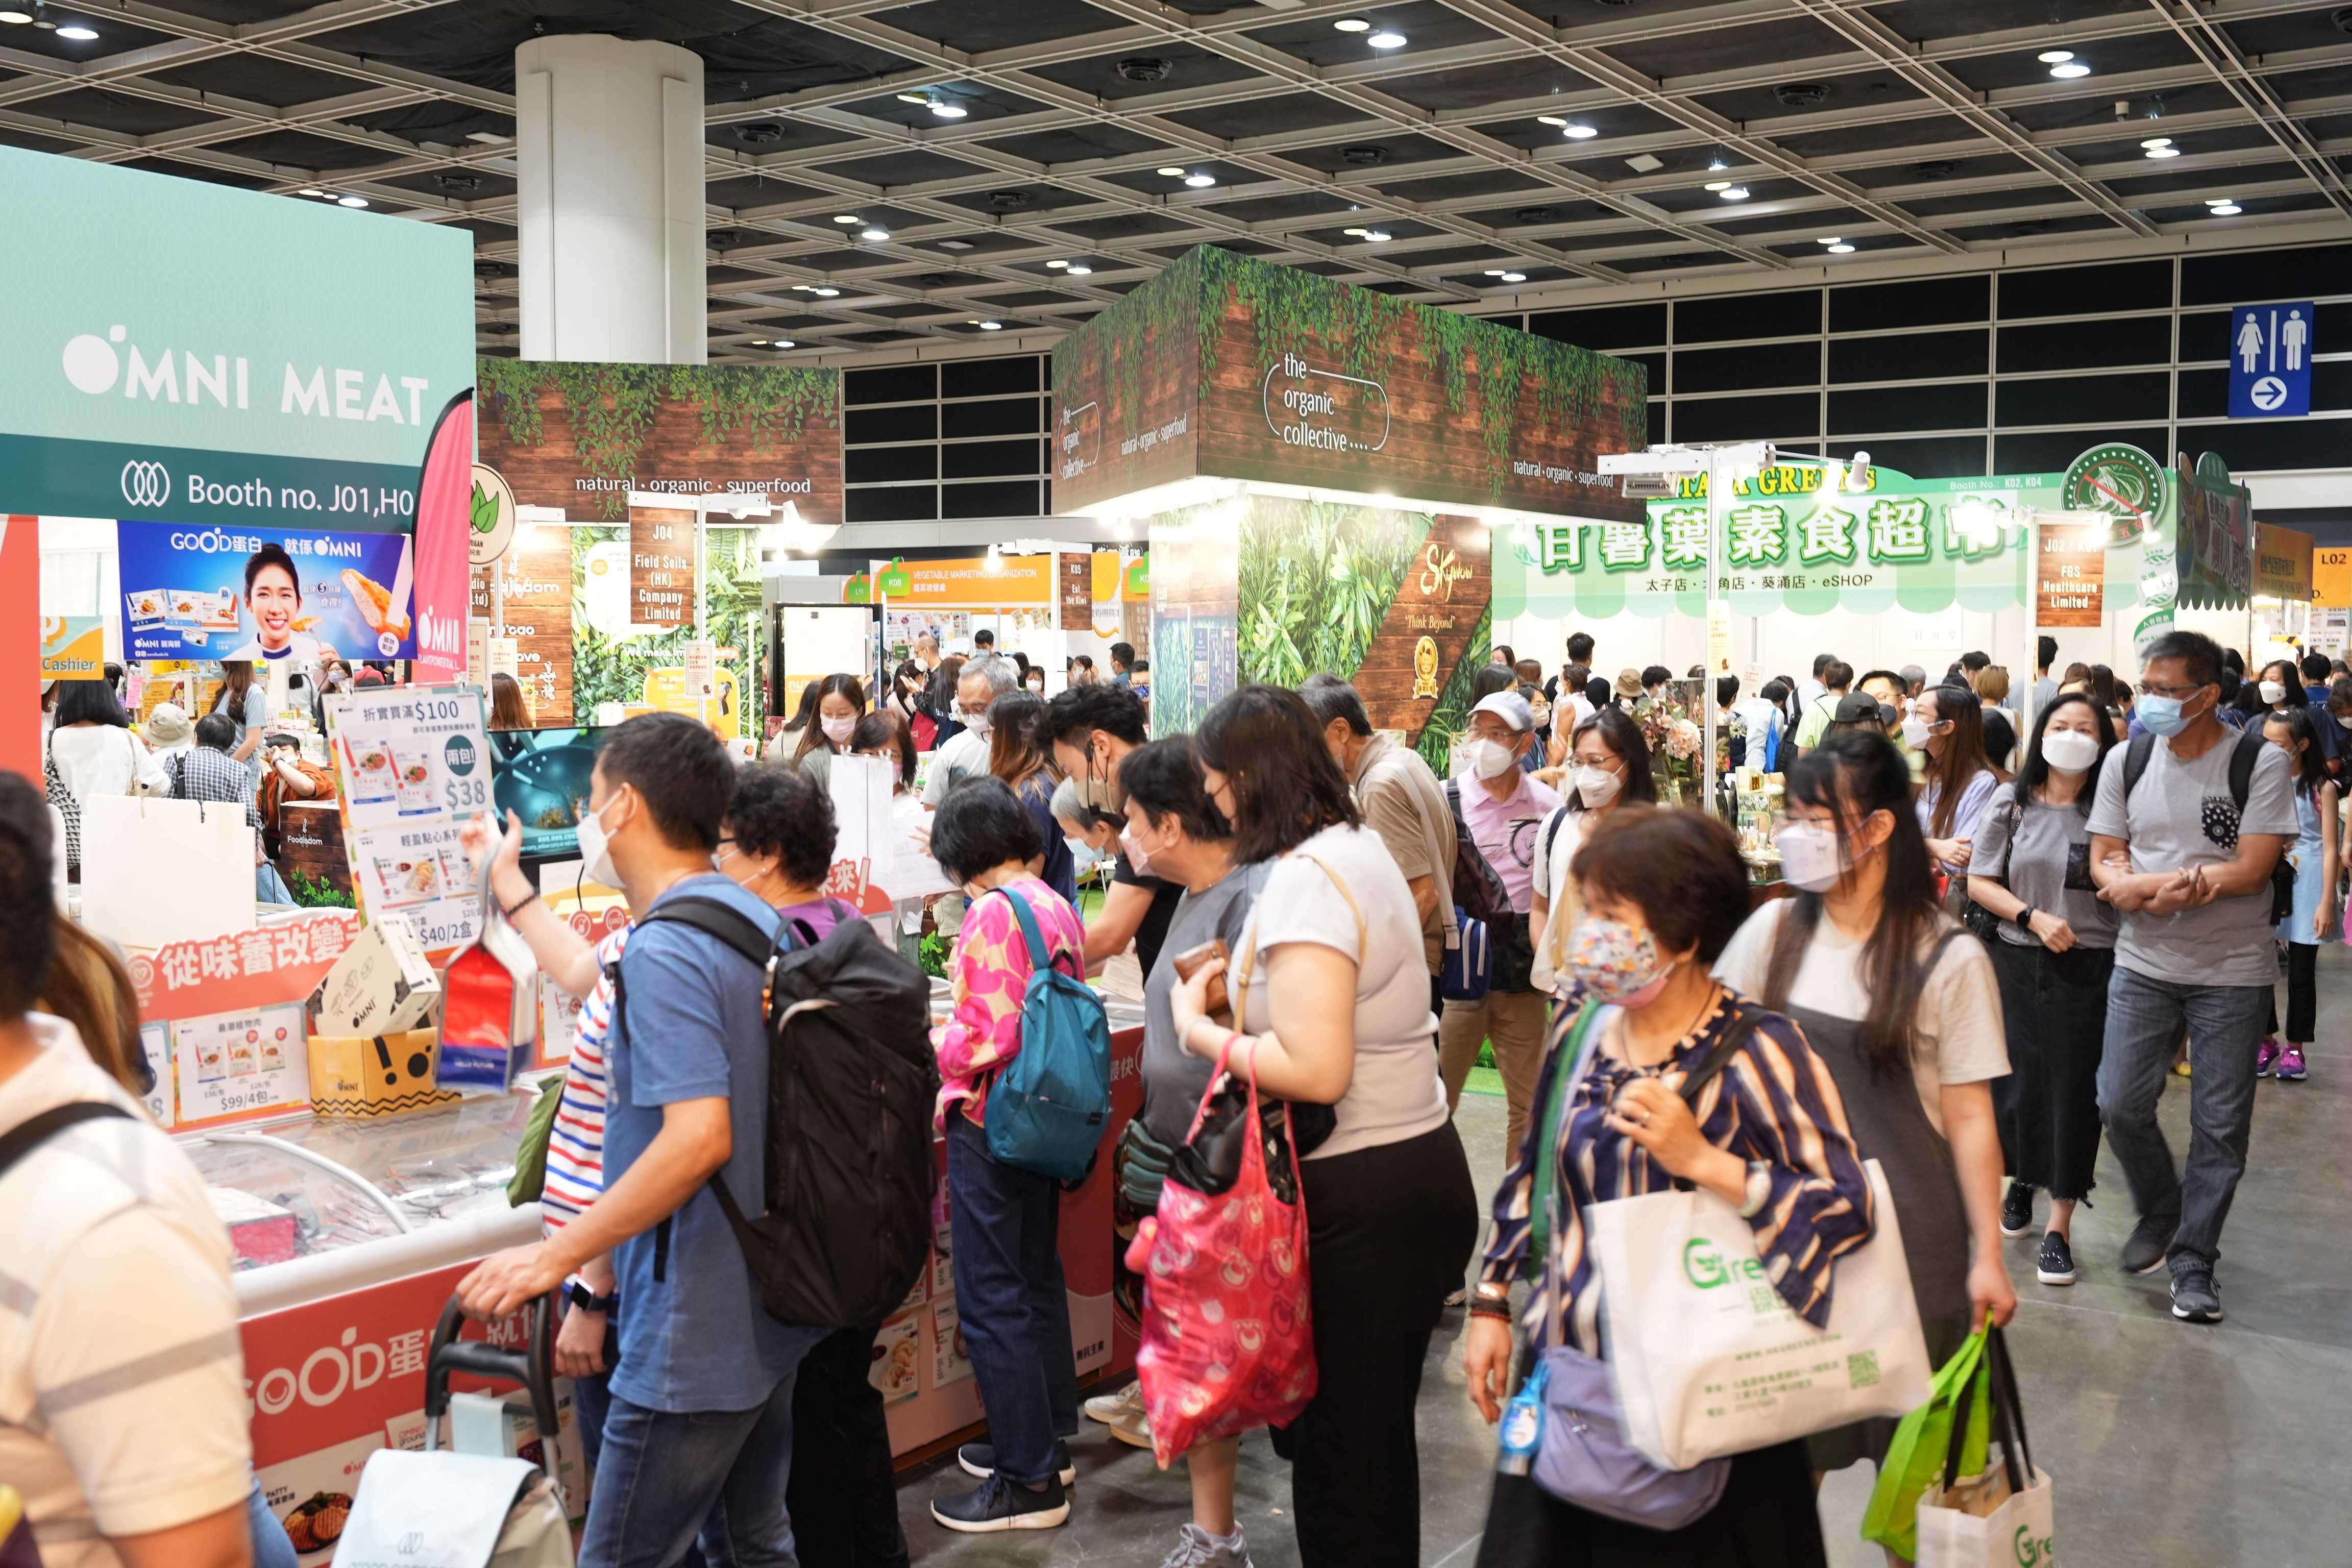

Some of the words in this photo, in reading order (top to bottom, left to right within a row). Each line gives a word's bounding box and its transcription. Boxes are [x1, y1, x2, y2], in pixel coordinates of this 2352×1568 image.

[1284, 352, 1307, 379] the
[63, 325, 249, 409] OMNI
[281, 361, 428, 426] MEAT
[1284, 389, 1335, 416] organic
[1063, 427, 1080, 454] organic
[1121, 433, 1137, 456] natural
[1140, 427, 1158, 453] organic
[1161, 412, 1187, 445] superfood
[1513, 460, 1541, 478] natural
[1546, 463, 1573, 485] organic
[1578, 470, 1613, 488] superfood
[575, 477, 635, 492] natural
[650, 478, 713, 494] organic
[727, 478, 811, 494] superfood
[1950, 481, 1976, 490] Booth
[2026, 477, 2042, 487] K04
[188, 475, 272, 507] Booth
[281, 490, 322, 510] no.
[653, 525, 672, 540] J04
[2045, 538, 2066, 553] J02
[635, 554, 658, 569] Field
[663, 555, 687, 570] Soils
[2322, 554, 2346, 565] L02
[913, 570, 949, 579] VEGETABLE
[950, 569, 987, 579] MARKETING
[1070, 564, 1081, 576] K05
[650, 572, 672, 588] (HK)
[889, 578, 902, 587] K08
[1646, 578, 1687, 592] 太子店
[1703, 576, 1745, 591] 角店
[1823, 574, 1872, 587] eSHOP
[2043, 580, 2098, 594] Healthcare
[1072, 584, 1080, 594] Eat
[640, 589, 682, 606] Company
[1066, 595, 1074, 605] the
[1075, 596, 1087, 606] Kiwi
[2051, 596, 2089, 608] Limited
[645, 606, 681, 621] Limited
[418, 605, 459, 653] OMNI
[134, 638, 159, 648] OMNI
[43, 657, 95, 671] Cashier
[445, 778, 485, 810] $38
[221, 1090, 268, 1111] $99/4包
